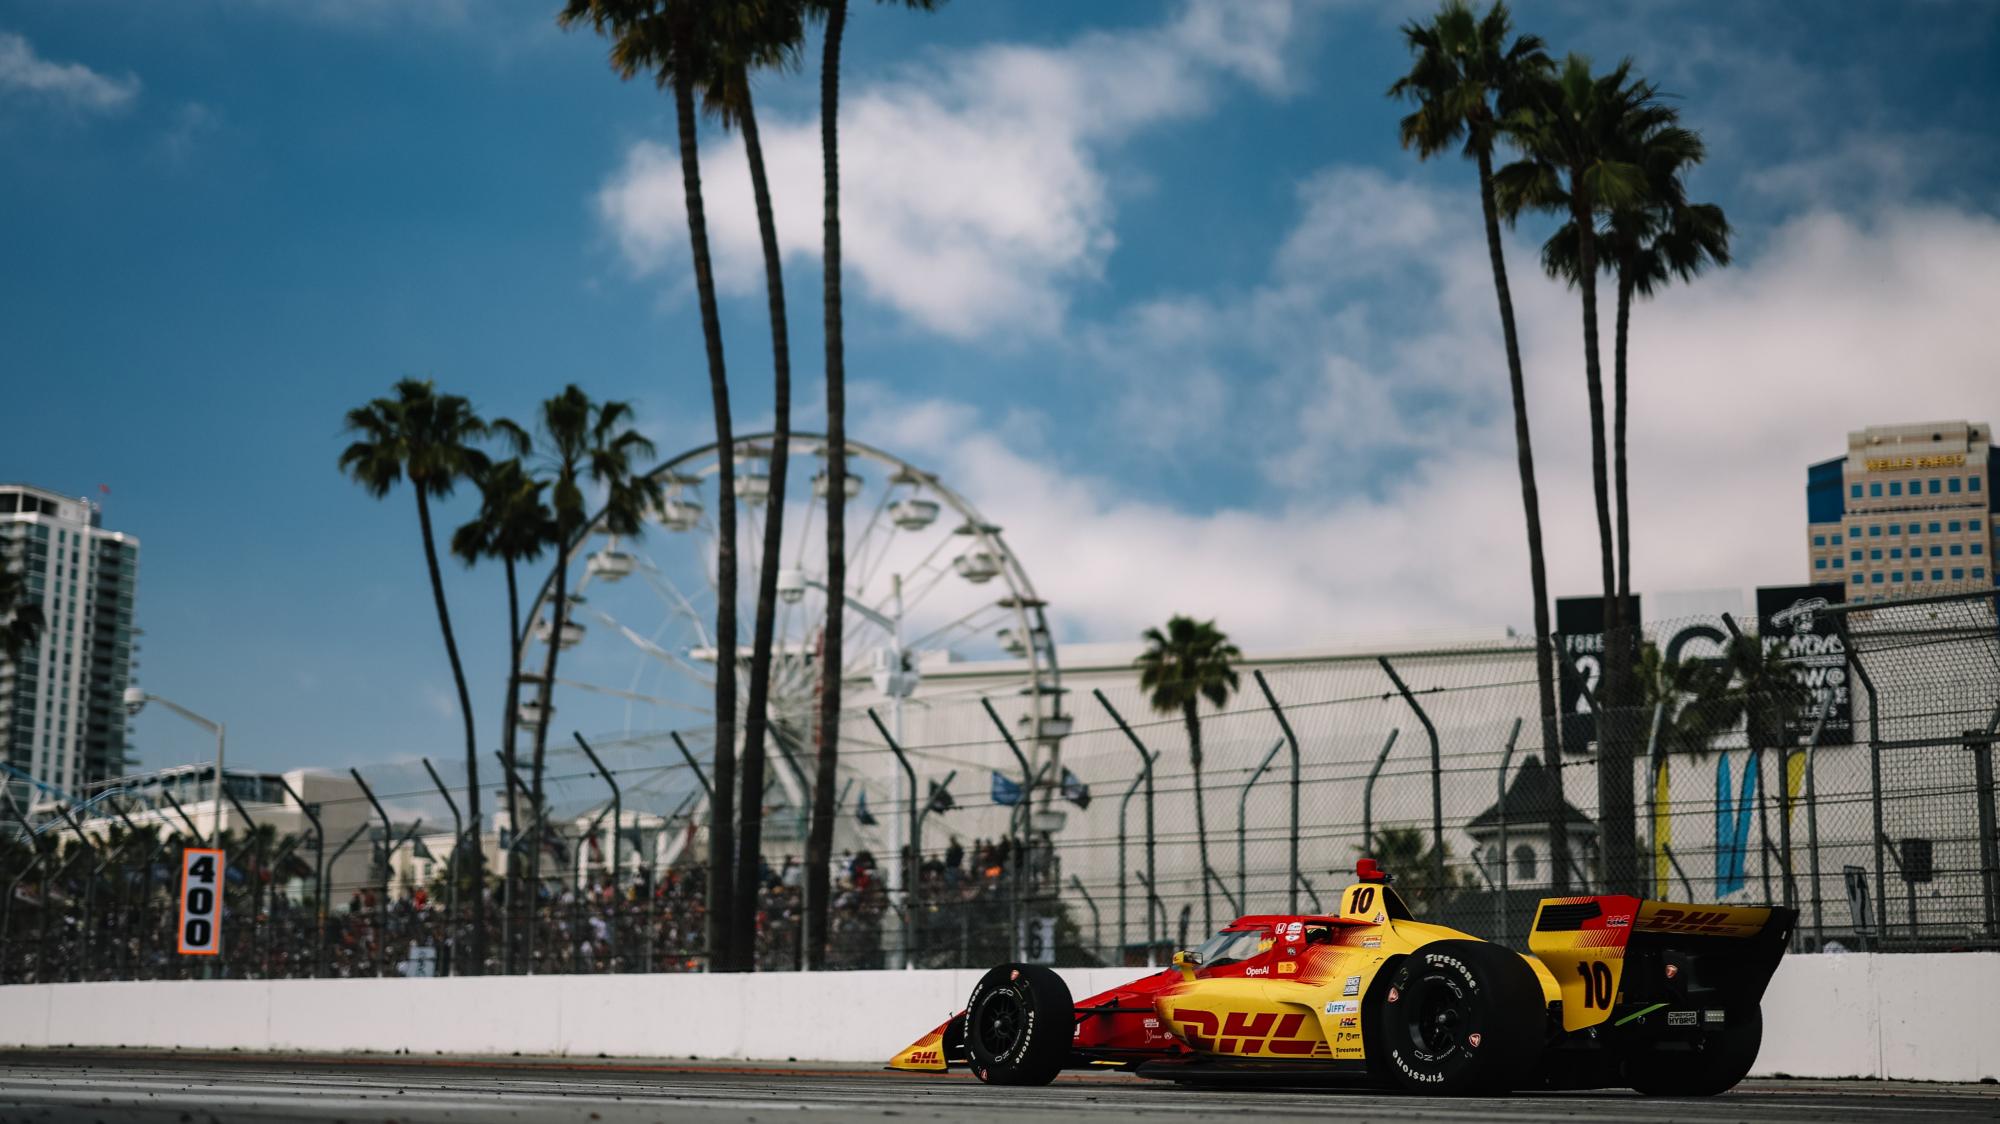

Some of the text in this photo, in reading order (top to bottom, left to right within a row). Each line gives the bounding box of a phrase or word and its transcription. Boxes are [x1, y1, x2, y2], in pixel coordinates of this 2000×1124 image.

[1864, 454, 1966, 472] WELLS FARGO
[185, 855, 215, 947] 400
[1349, 887, 1375, 914] 10
[1649, 909, 1729, 932] DHL
[1245, 965, 1270, 977] OpenAI
[1425, 953, 1477, 988] Firestone
[1576, 960, 1613, 1010] 10
[1172, 1008, 1317, 1055] DHL
[1669, 1016, 1696, 1024] HYBRID
[1016, 1010, 1035, 1064] Firestone
[911, 1051, 939, 1064] DHL
[1392, 1049, 1445, 1083] Firestone
